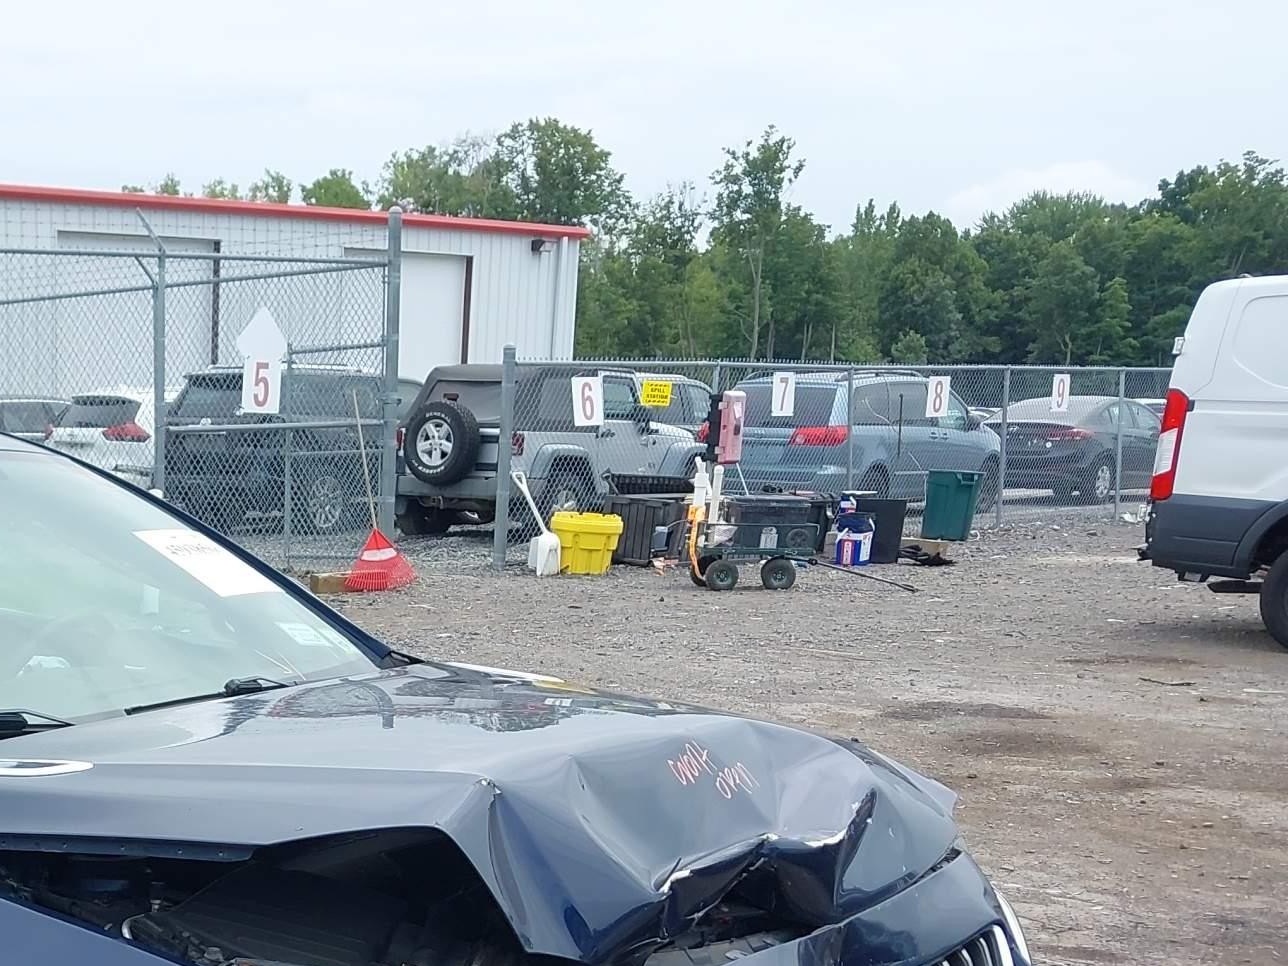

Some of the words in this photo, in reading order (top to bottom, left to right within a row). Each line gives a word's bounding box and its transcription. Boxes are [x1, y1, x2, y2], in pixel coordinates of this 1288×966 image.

[253, 362, 269, 407] 5
[581, 382, 594, 420] 6
[779, 377, 789, 412] 7
[933, 380, 943, 413] 8
[1057, 378, 1065, 409] 9
